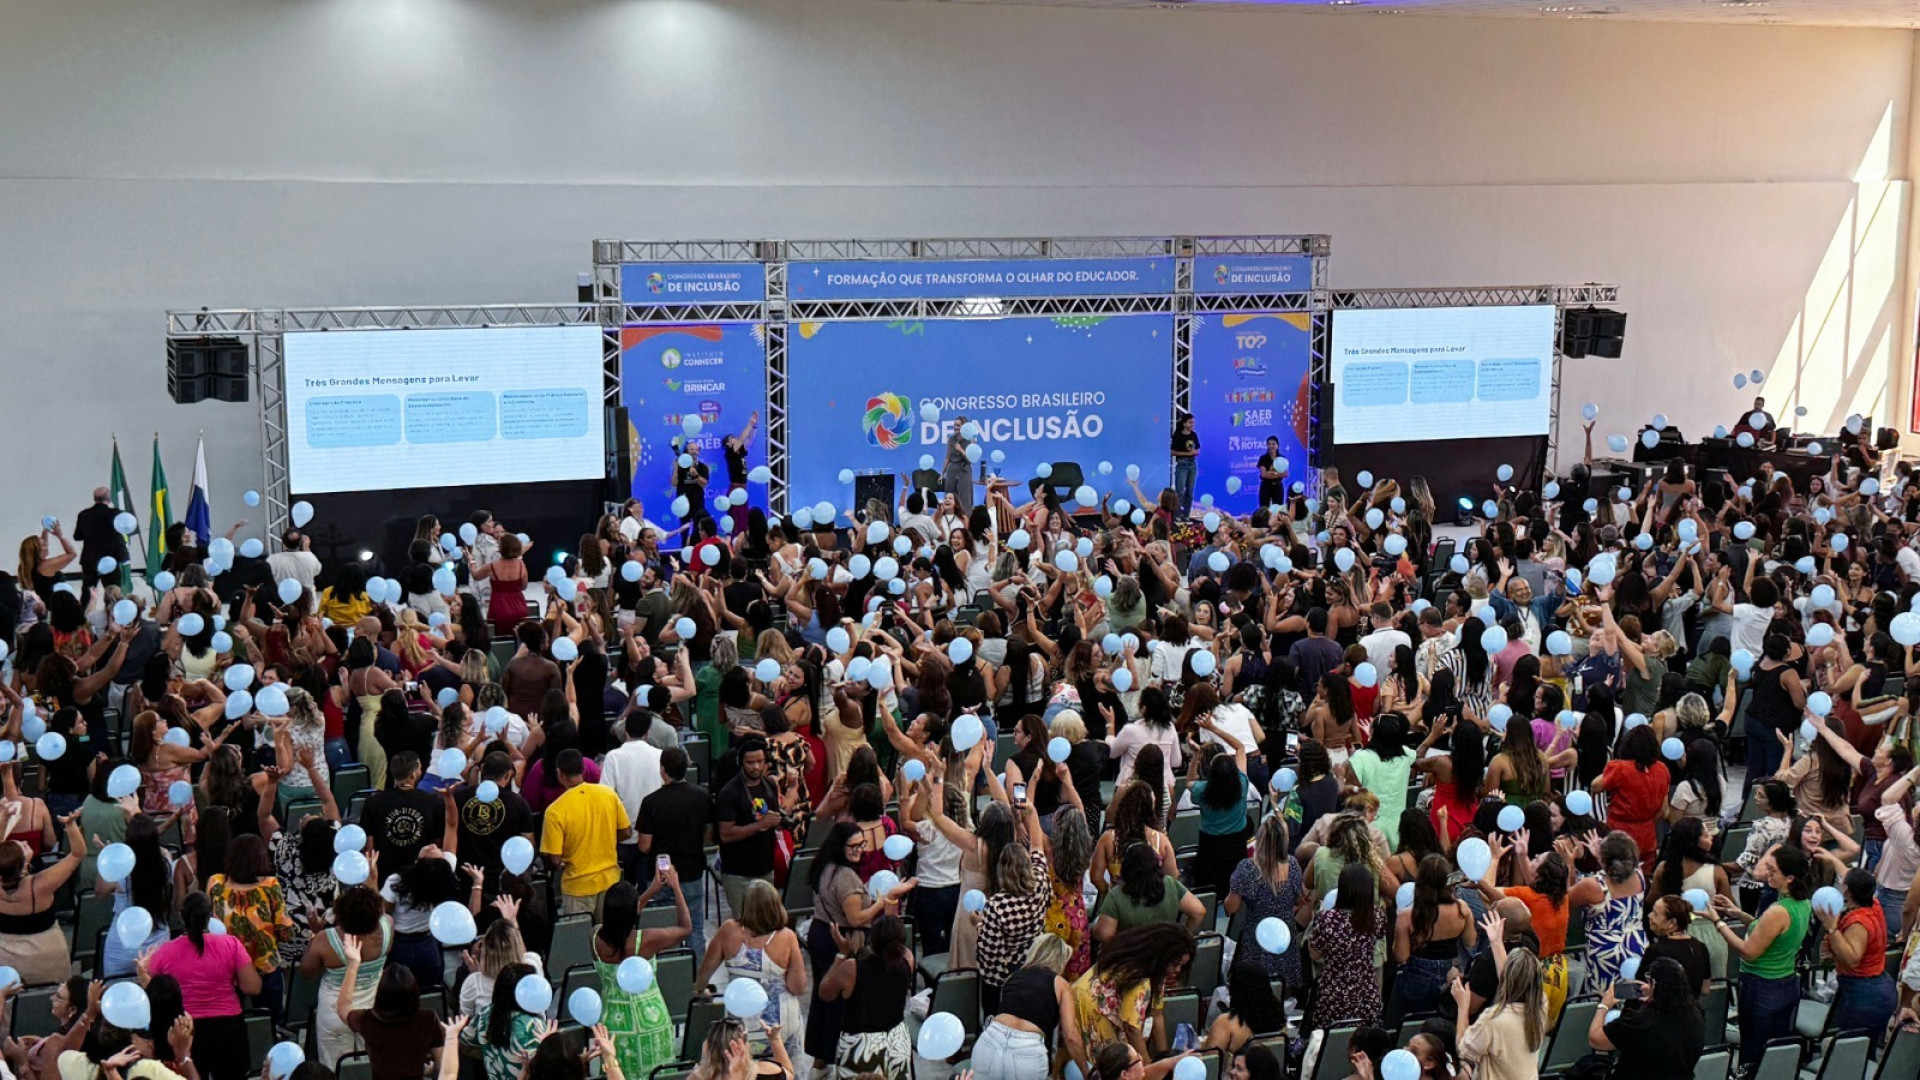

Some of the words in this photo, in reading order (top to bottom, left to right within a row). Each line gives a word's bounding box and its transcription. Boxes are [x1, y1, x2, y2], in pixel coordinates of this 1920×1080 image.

[828, 272, 896, 288] FORMAÇÃO
[900, 274, 922, 286] QUE
[926, 272, 1002, 284] TRANSFORMA
[1006, 272, 1014, 283] O
[1017, 272, 1054, 282] OLHAR
[1057, 272, 1073, 282] DO
[1076, 270, 1139, 282] EDUCADOR.
[1231, 274, 1243, 282] DE
[1245, 272, 1290, 282] INCLUSÃO
[668, 282, 682, 292] DE
[684, 280, 740, 292] INCLUSÃO
[684, 358, 724, 366] CONHECER
[304, 378, 326, 388] Três
[329, 377, 370, 386] Grandes
[372, 376, 427, 386] Mensagens
[428, 376, 450, 384] para
[684, 382, 726, 392] BRINCAR
[919, 394, 1018, 411] CONGRESSO
[1021, 391, 1106, 408] BRASILEIRO
[1244, 409, 1272, 420] SAEB
[970, 410, 1104, 443] NCLUSÃO
